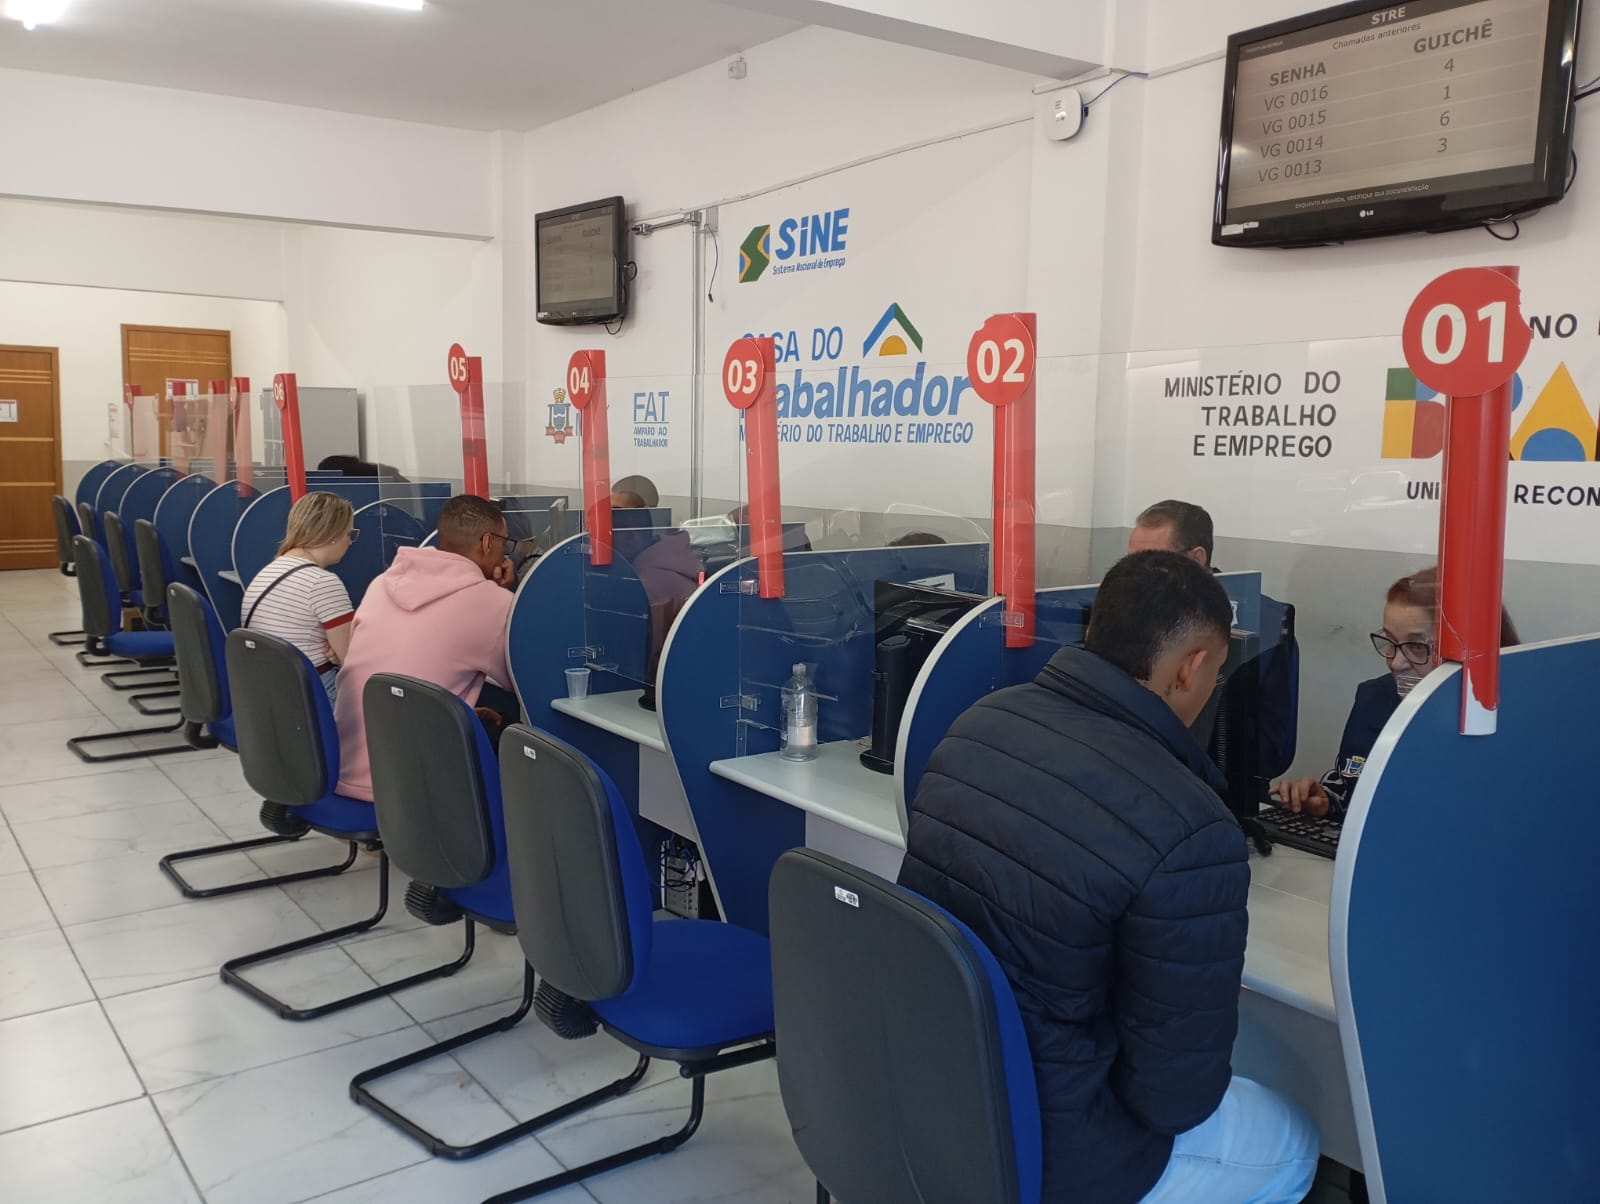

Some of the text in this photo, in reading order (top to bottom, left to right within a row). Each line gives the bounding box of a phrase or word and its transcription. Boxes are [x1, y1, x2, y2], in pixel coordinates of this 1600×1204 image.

[1371, 6, 1406, 25] STRE
[1332, 23, 1421, 50] Chamadas anteriores
[1413, 18, 1493, 53] GUICHÊ
[1269, 61, 1327, 87] SENHA
[1444, 57, 1455, 72] 4
[1264, 85, 1328, 111] VG 0016
[1443, 84, 1452, 100] 1
[1262, 110, 1326, 135] VG 0015
[1439, 110, 1450, 126] 6
[1260, 135, 1323, 159] VG 0014
[1437, 137, 1448, 153] 3
[1258, 159, 1322, 182] VG 0013
[772, 264, 795, 276] Sistema
[1421, 301, 1507, 365] 01
[1529, 313, 1578, 339] NO
[743, 326, 844, 363] SA DO
[450, 356, 467, 382] 05
[976, 338, 1025, 385] 02
[570, 366, 590, 395] 04
[727, 359, 758, 395] 03
[741, 361, 974, 419] abalhador
[1164, 370, 1341, 398] MINISTÉRIO DO
[273, 383, 285, 401] 06
[633, 391, 669, 422] FAT
[1201, 404, 1337, 427] TRABALHO
[633, 426, 668, 436] AMPARO AO
[806, 424, 823, 442] DO
[827, 423, 892, 443] TRABALHO
[894, 423, 903, 443] E
[906, 422, 974, 444] EMPREGO
[1193, 434, 1332, 458] E EMPREGO
[1407, 480, 1600, 506] UNI RECON
